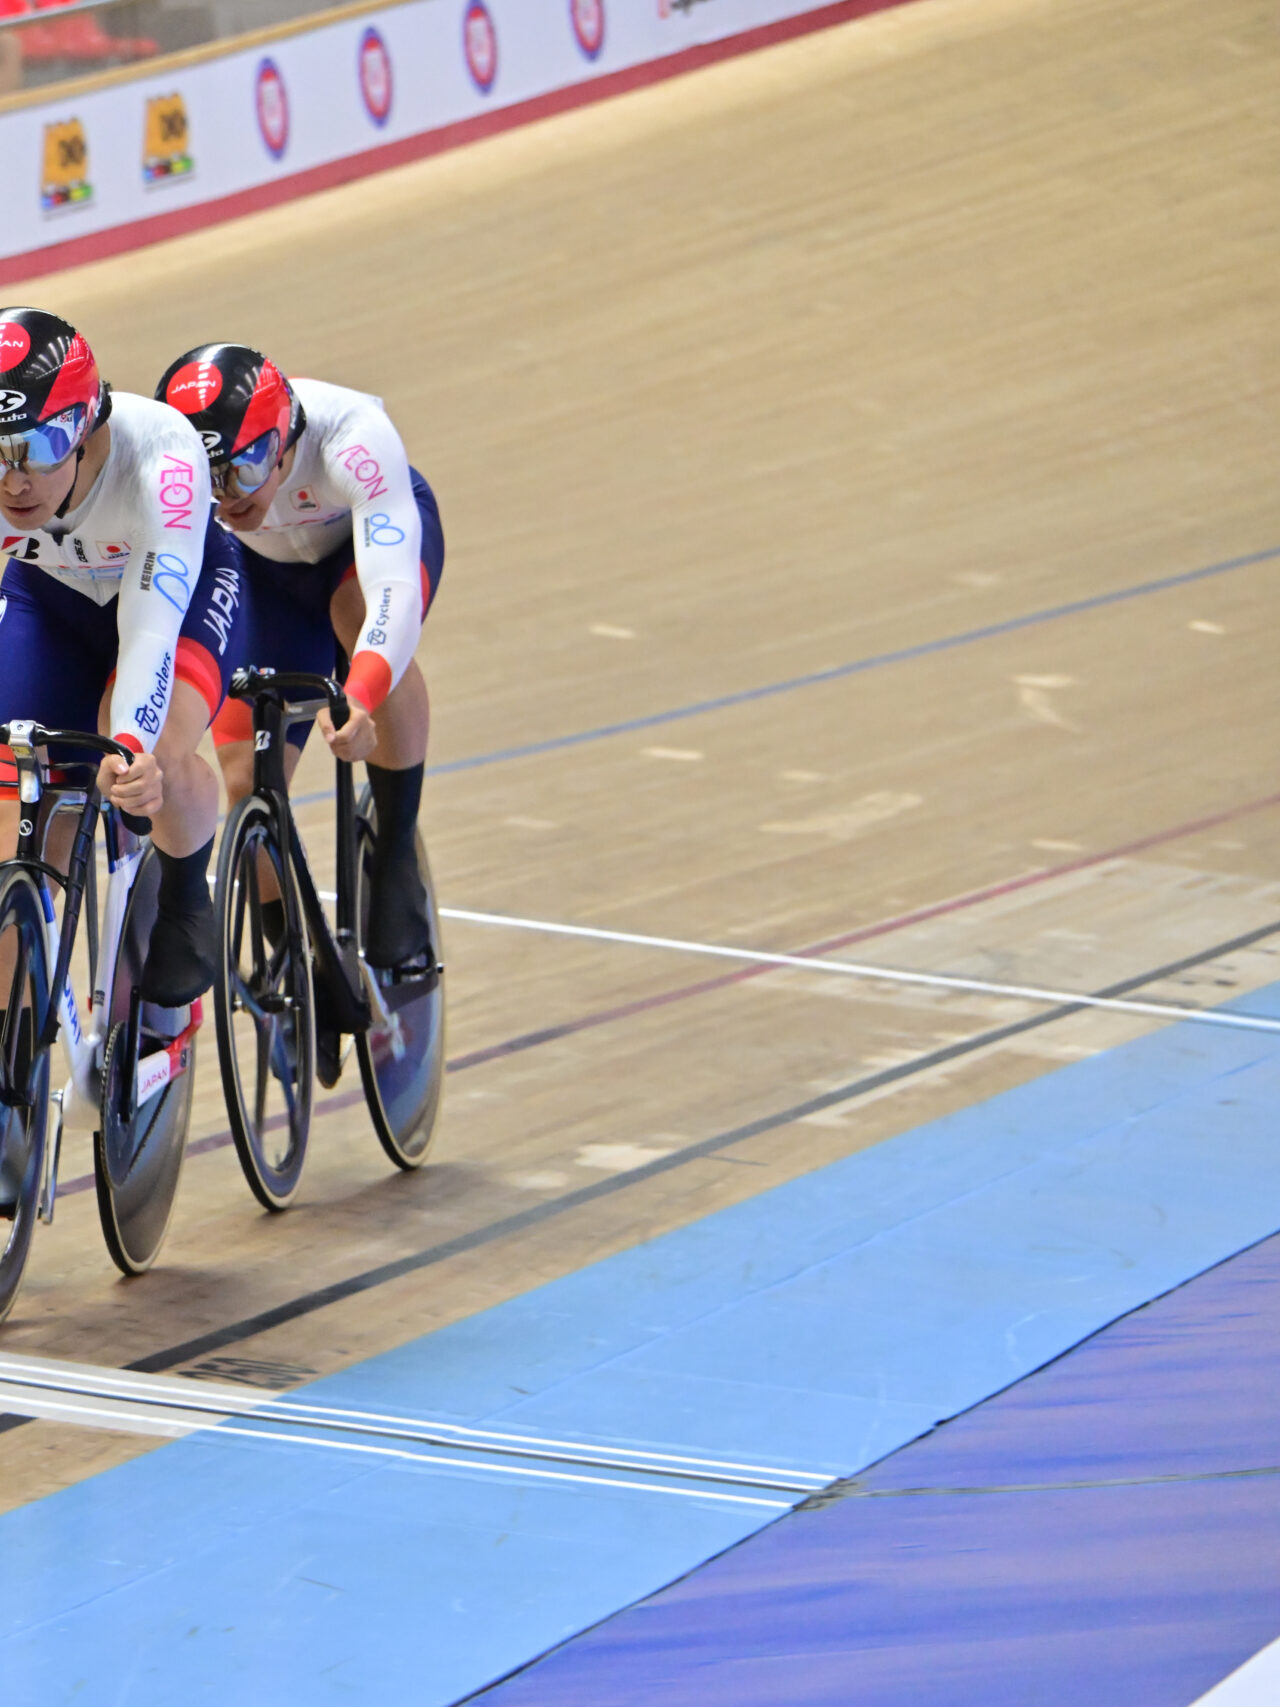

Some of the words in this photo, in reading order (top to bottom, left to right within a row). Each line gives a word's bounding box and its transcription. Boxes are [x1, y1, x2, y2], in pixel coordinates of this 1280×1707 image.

[140, 551, 157, 592] KEIRIN
[203, 567, 240, 656] JAPAN
[376, 587, 391, 626] Cyclers
[150, 652, 172, 709] Cyclers
[141, 1067, 168, 1094] JAPAN
